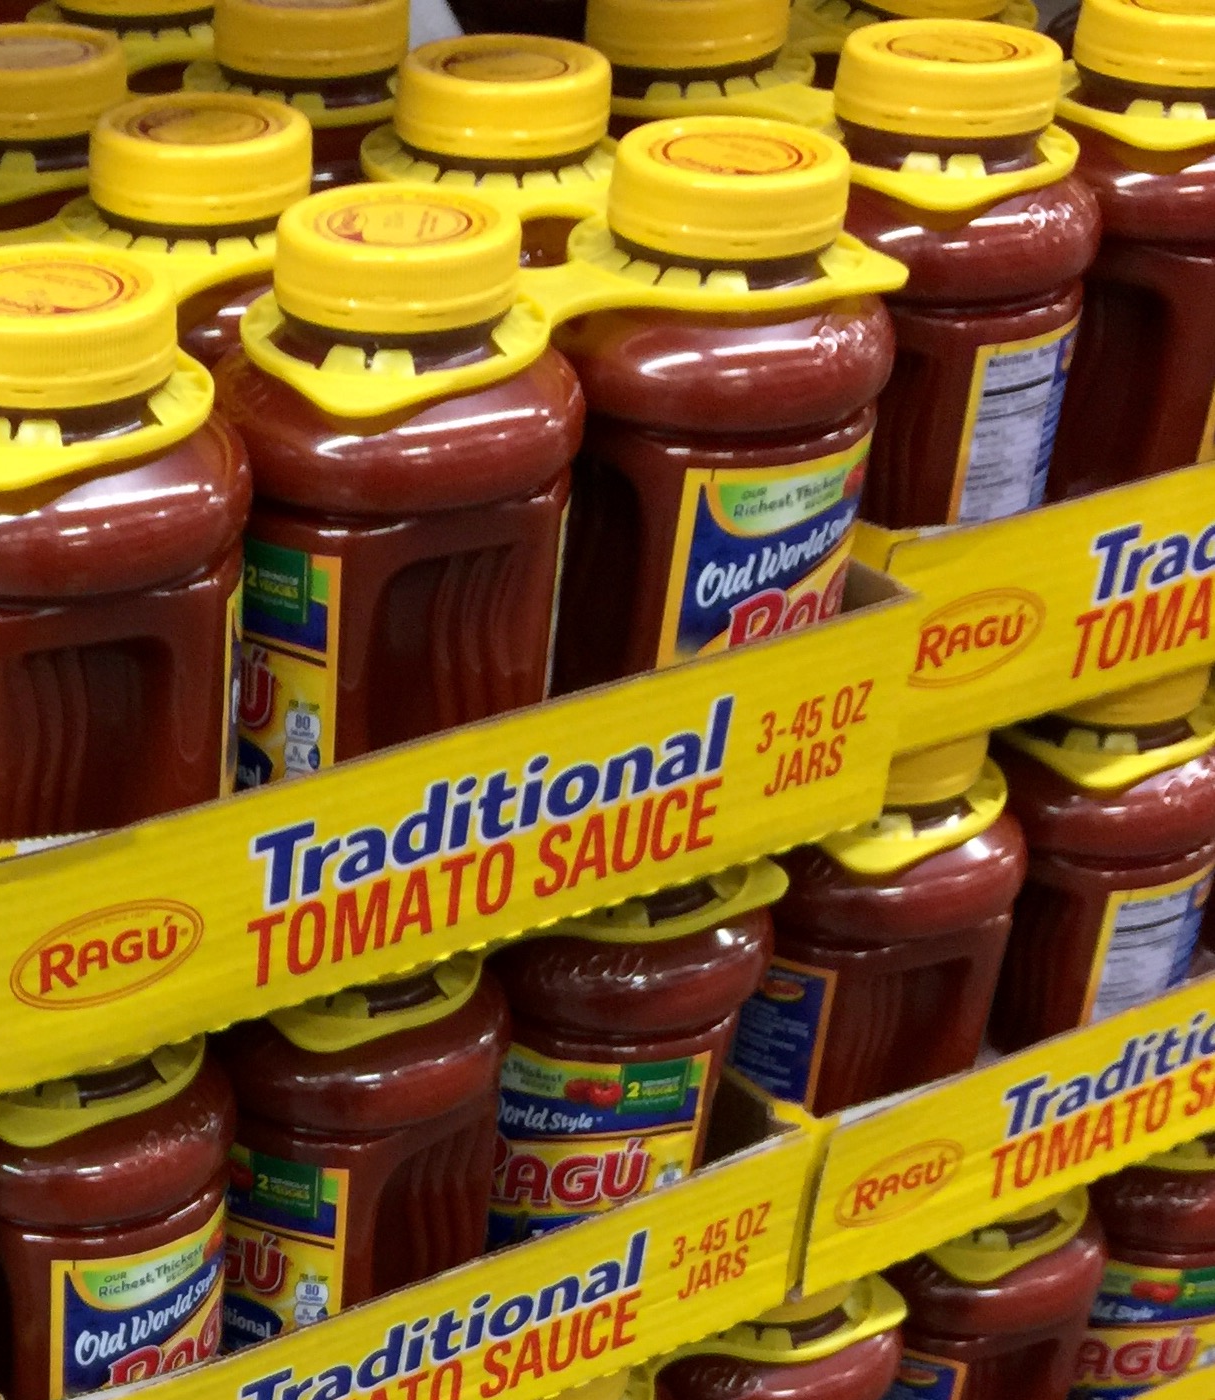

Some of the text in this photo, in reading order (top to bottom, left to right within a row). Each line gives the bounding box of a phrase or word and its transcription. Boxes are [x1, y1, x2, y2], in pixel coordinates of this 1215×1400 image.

[696, 521, 829, 608] Old World
[913, 603, 1026, 673] RAGÚ
[756, 681, 874, 755] 3-45 OZ
[763, 734, 847, 797] JARS
[252, 695, 734, 906] Traditional
[247, 777, 722, 988] TOMATO SAUCE
[39, 915, 177, 994] RAGÚ
[549, 1113, 593, 1133] Style
[627, 1081, 642, 1098] 2
[989, 1078, 1174, 1198] TOMATO
[258, 1174, 269, 1190] 2
[851, 1154, 950, 1217] RAGÚ
[669, 1201, 772, 1270] 3-45 OZ
[99, 1273, 156, 1297] Richest,
[104, 1272, 127, 1283] OUR
[677, 1245, 750, 1301] JARS
[74, 1286, 193, 1366] Old World
[480, 1289, 641, 1397] SAUCE
